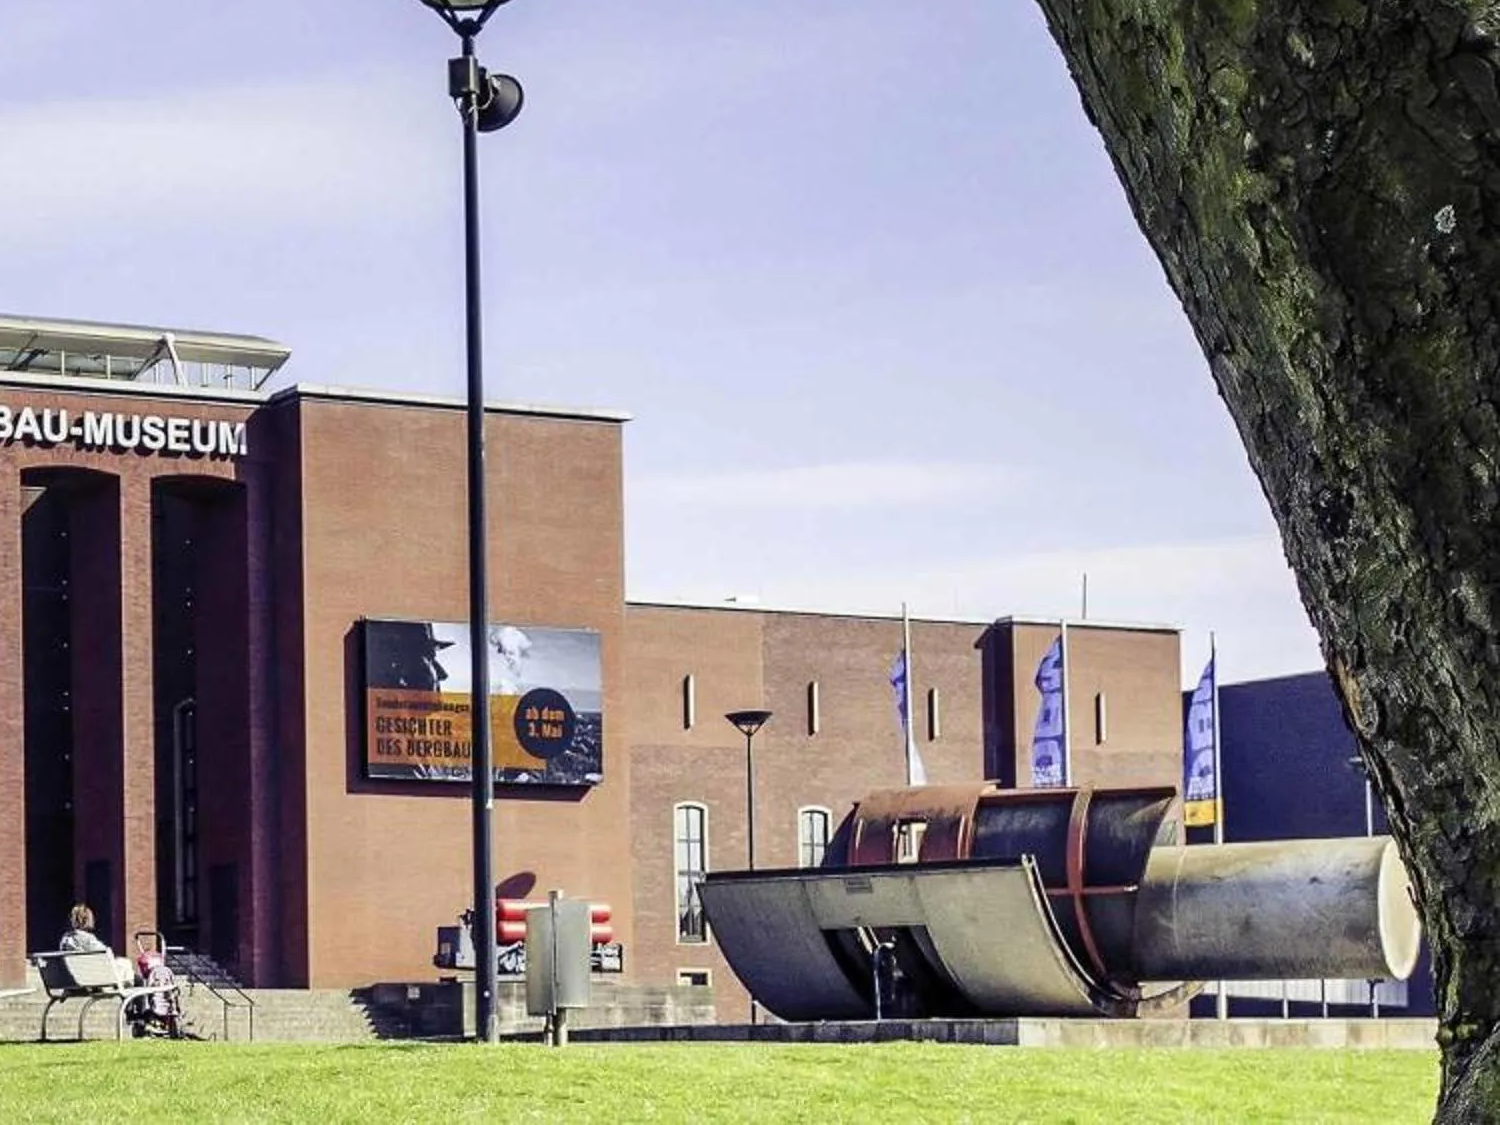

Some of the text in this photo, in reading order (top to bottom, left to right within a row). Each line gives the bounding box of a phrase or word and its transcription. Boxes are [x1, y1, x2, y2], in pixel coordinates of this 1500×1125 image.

[375, 716, 452, 736] GESICHTER
[377, 738, 471, 759] DES BERGBAU
